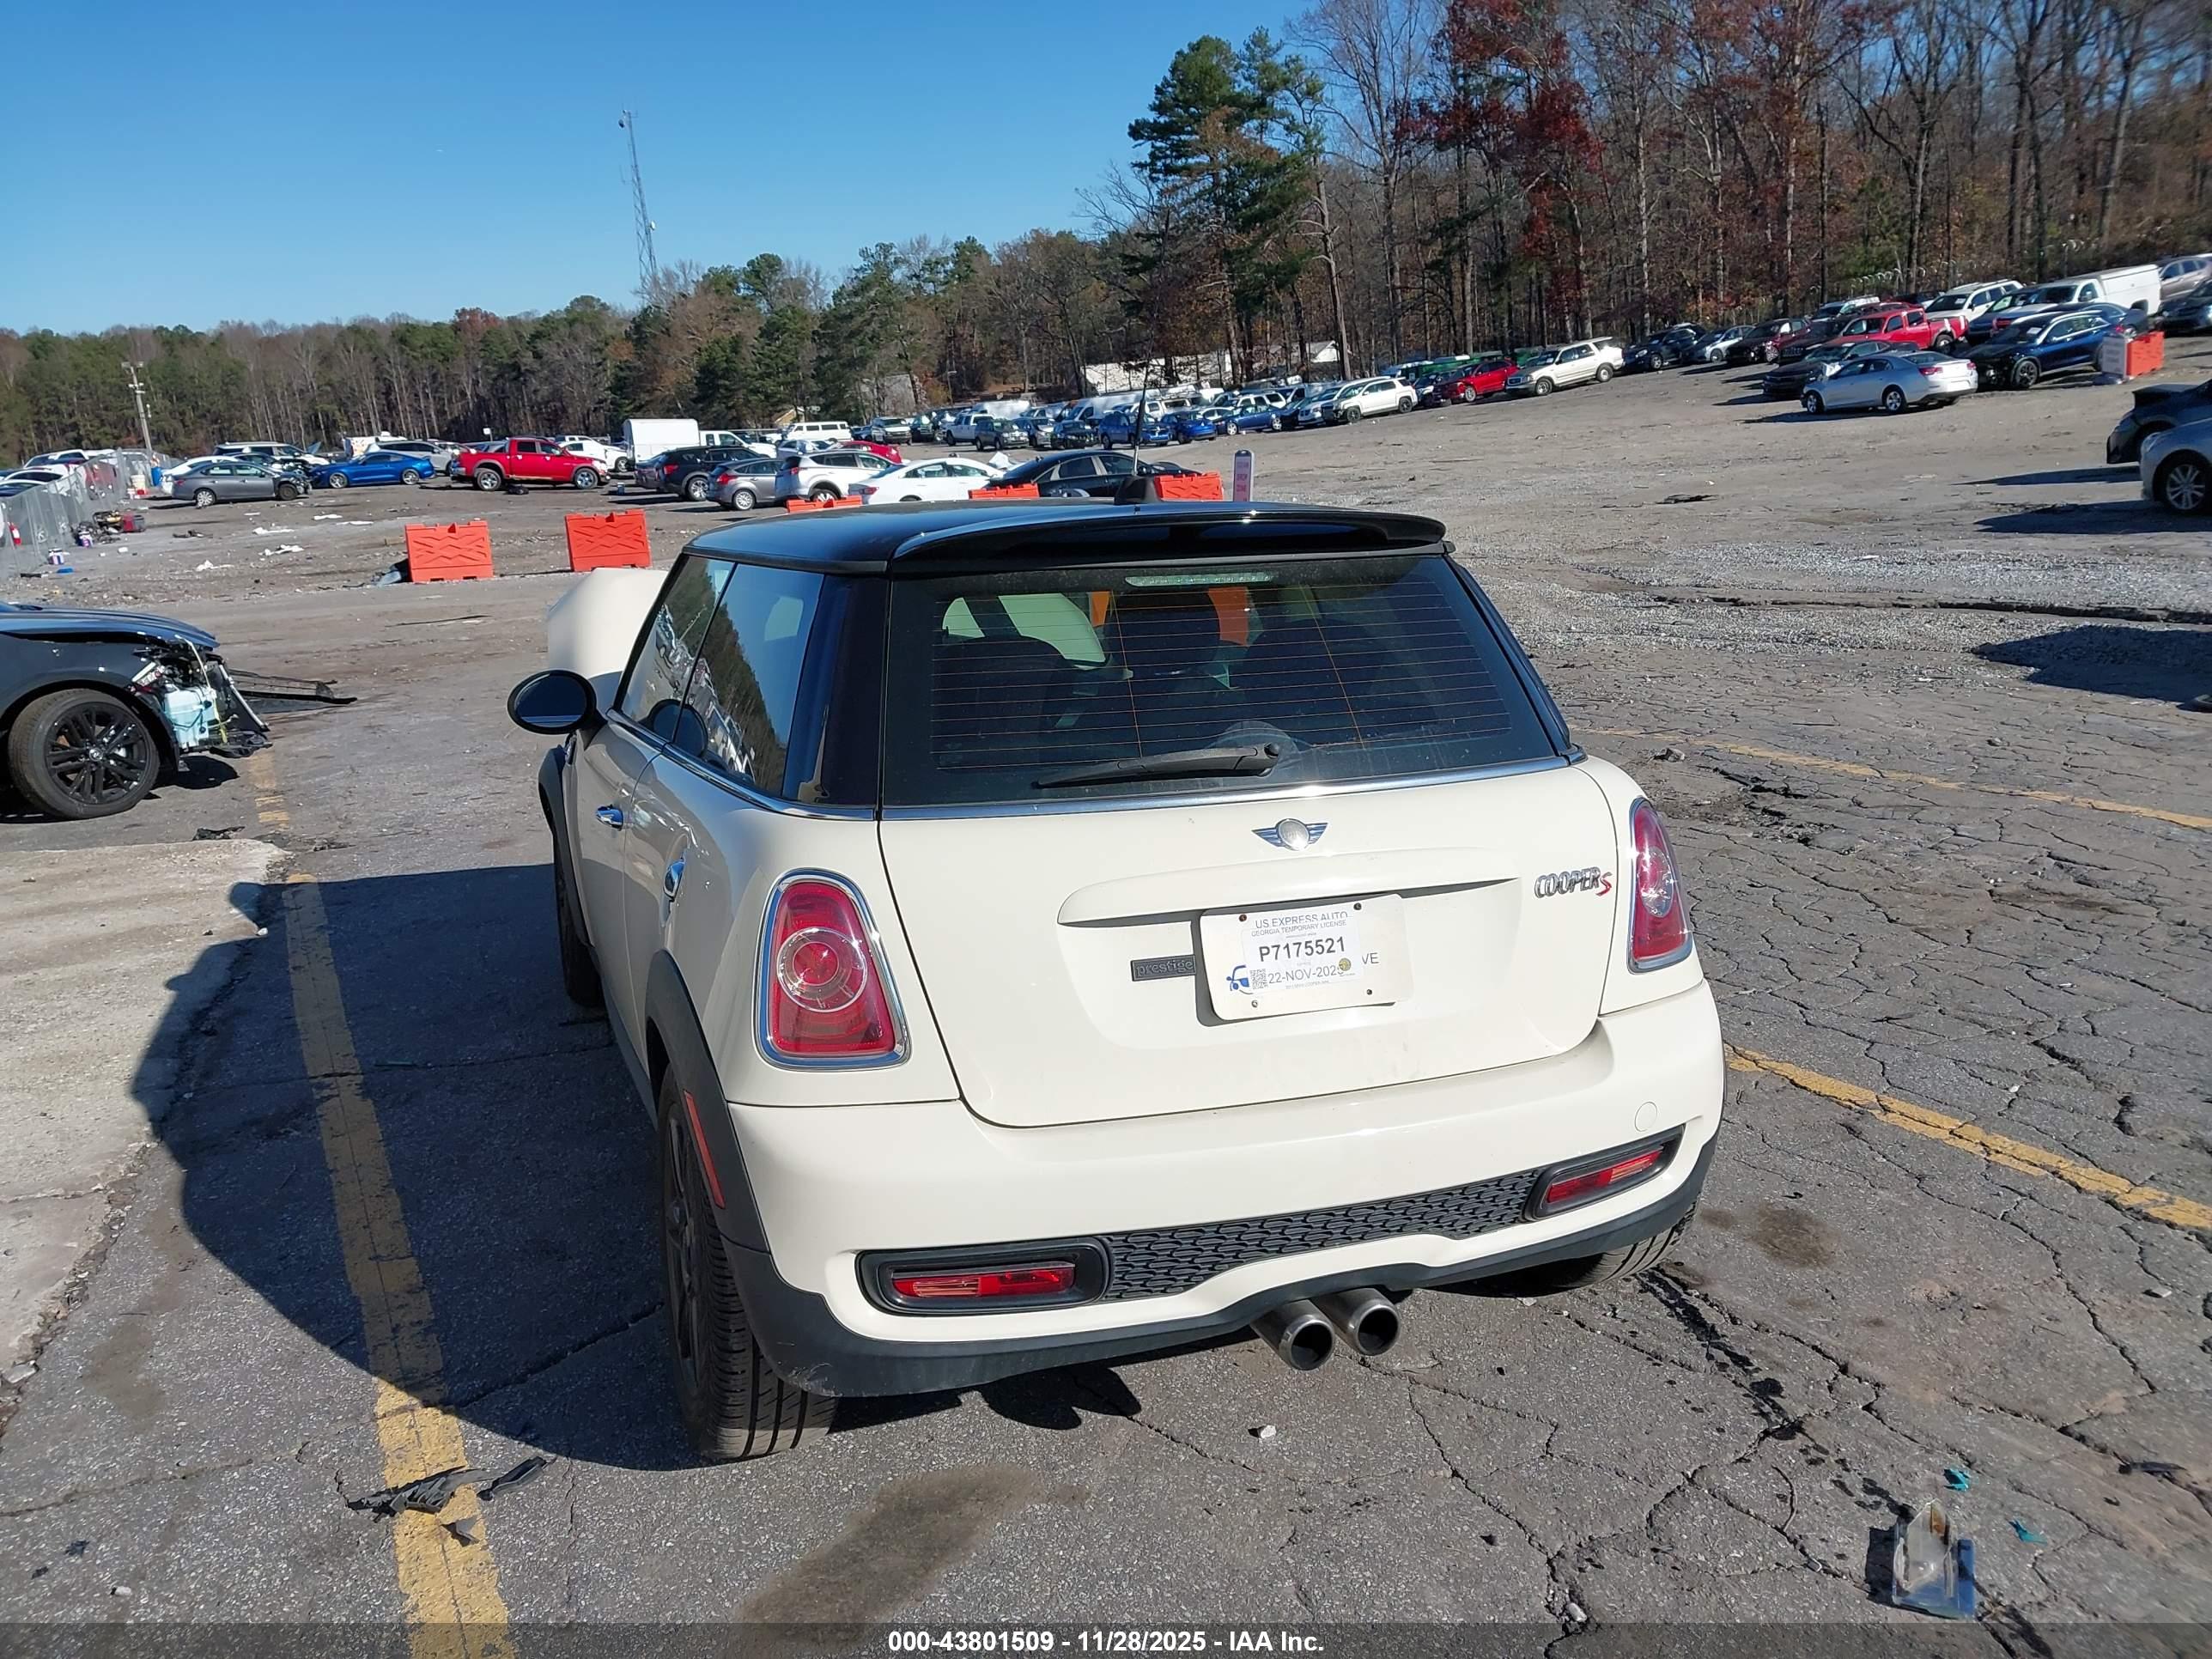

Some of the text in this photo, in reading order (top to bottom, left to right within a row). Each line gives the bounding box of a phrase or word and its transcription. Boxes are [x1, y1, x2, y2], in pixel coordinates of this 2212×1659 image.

[1534, 866, 1613, 898] COOPER S
[1251, 927, 1280, 937] GEORGIA
[1281, 923, 1319, 933] TEMPORARY
[1320, 920, 1346, 928] LICENSE
[1255, 911, 1348, 929] US EXPRESS AUTO
[1259, 936, 1345, 962] P7175521
[1135, 959, 1194, 978] prestige
